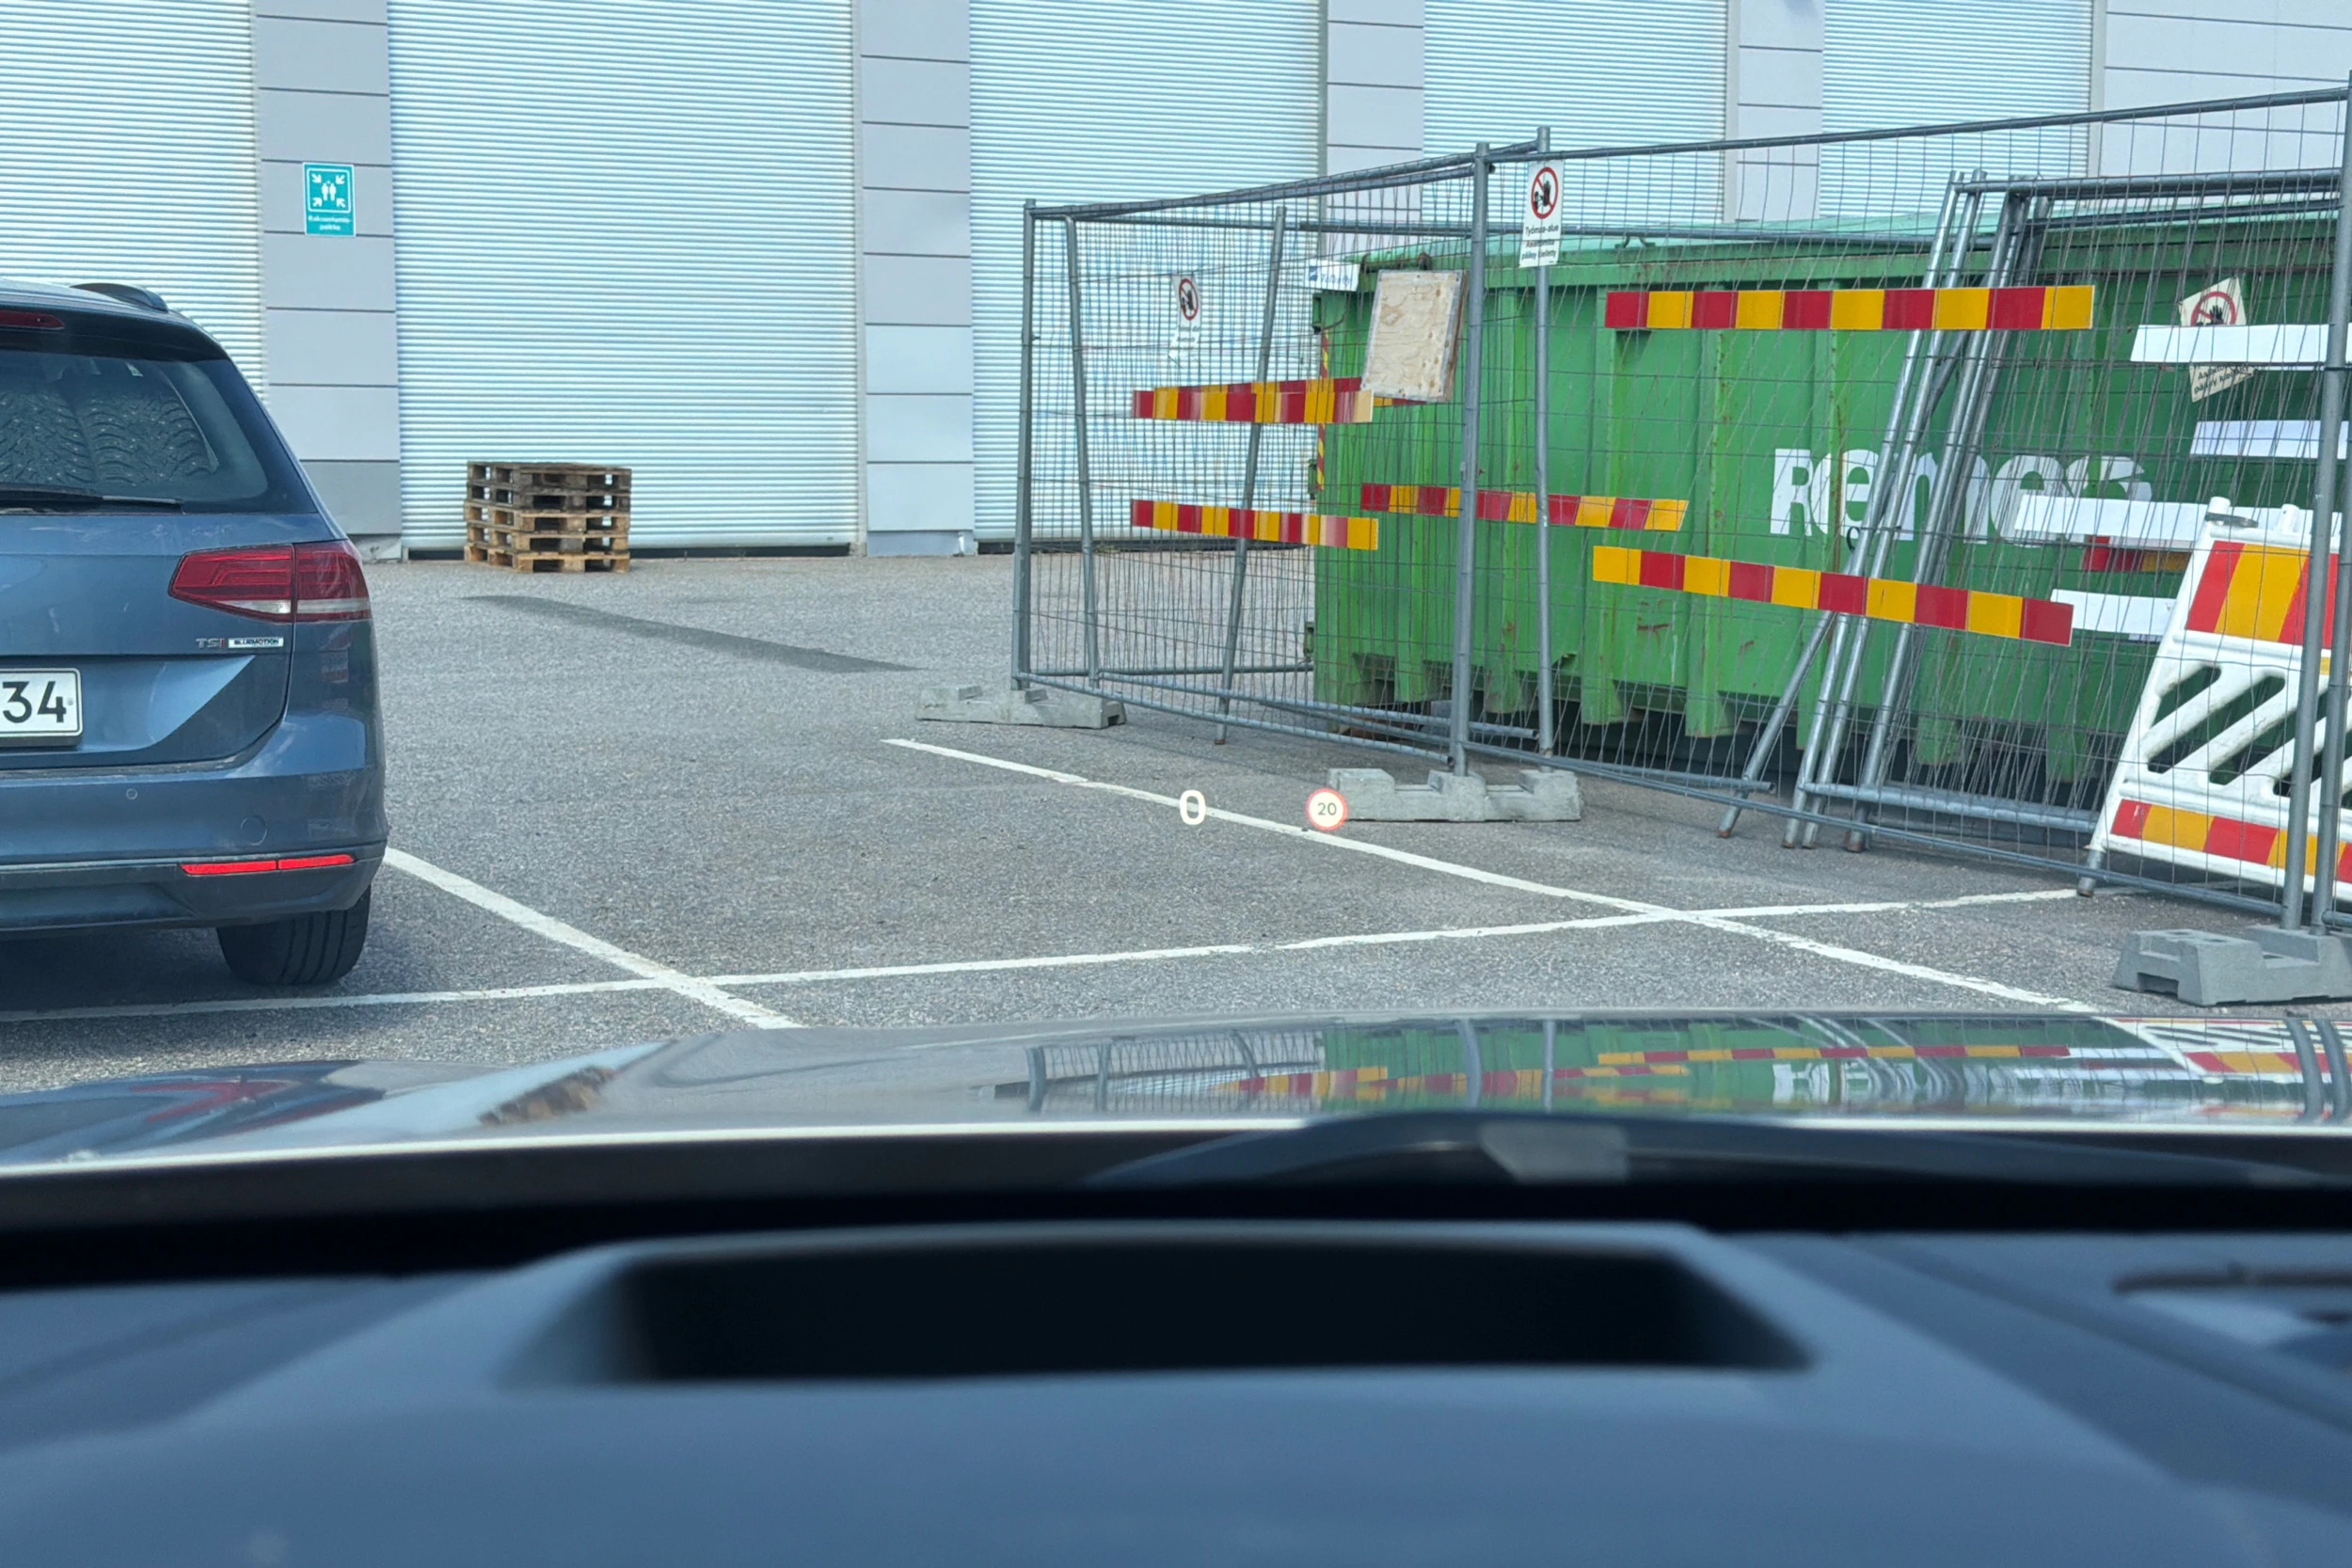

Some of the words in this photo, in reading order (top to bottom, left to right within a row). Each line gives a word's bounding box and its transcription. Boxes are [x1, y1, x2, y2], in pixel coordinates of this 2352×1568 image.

[196, 639, 225, 648] TSI
[2, 680, 67, 723] 34
[1179, 789, 1206, 825] 0
[1317, 802, 1338, 816] 20
